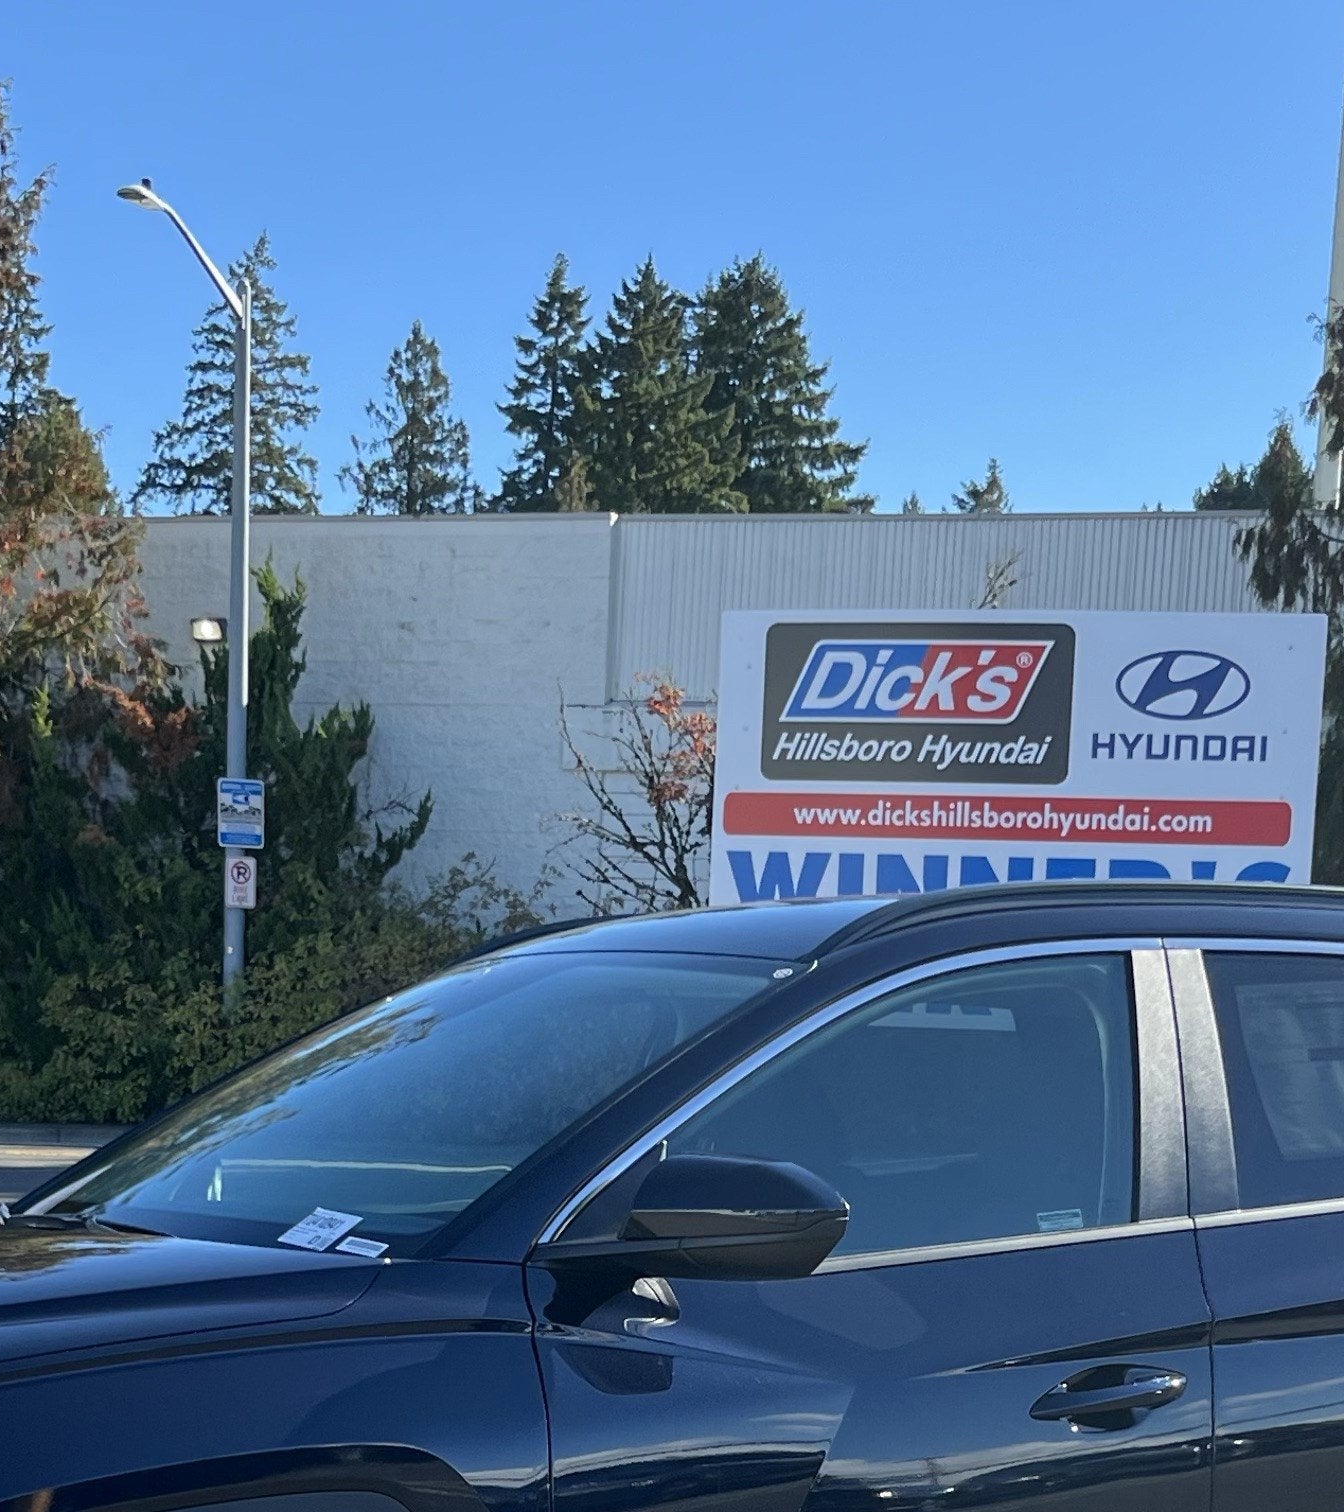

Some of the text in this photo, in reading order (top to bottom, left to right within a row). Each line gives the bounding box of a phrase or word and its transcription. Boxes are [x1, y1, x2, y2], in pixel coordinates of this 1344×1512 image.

[801, 650, 1018, 713] Dick's
[772, 733, 1052, 770] Hillsboro Hyundai
[1092, 733, 1267, 762] HYUNDAI
[794, 801, 1213, 837] www.dickshillsborohyundai.com
